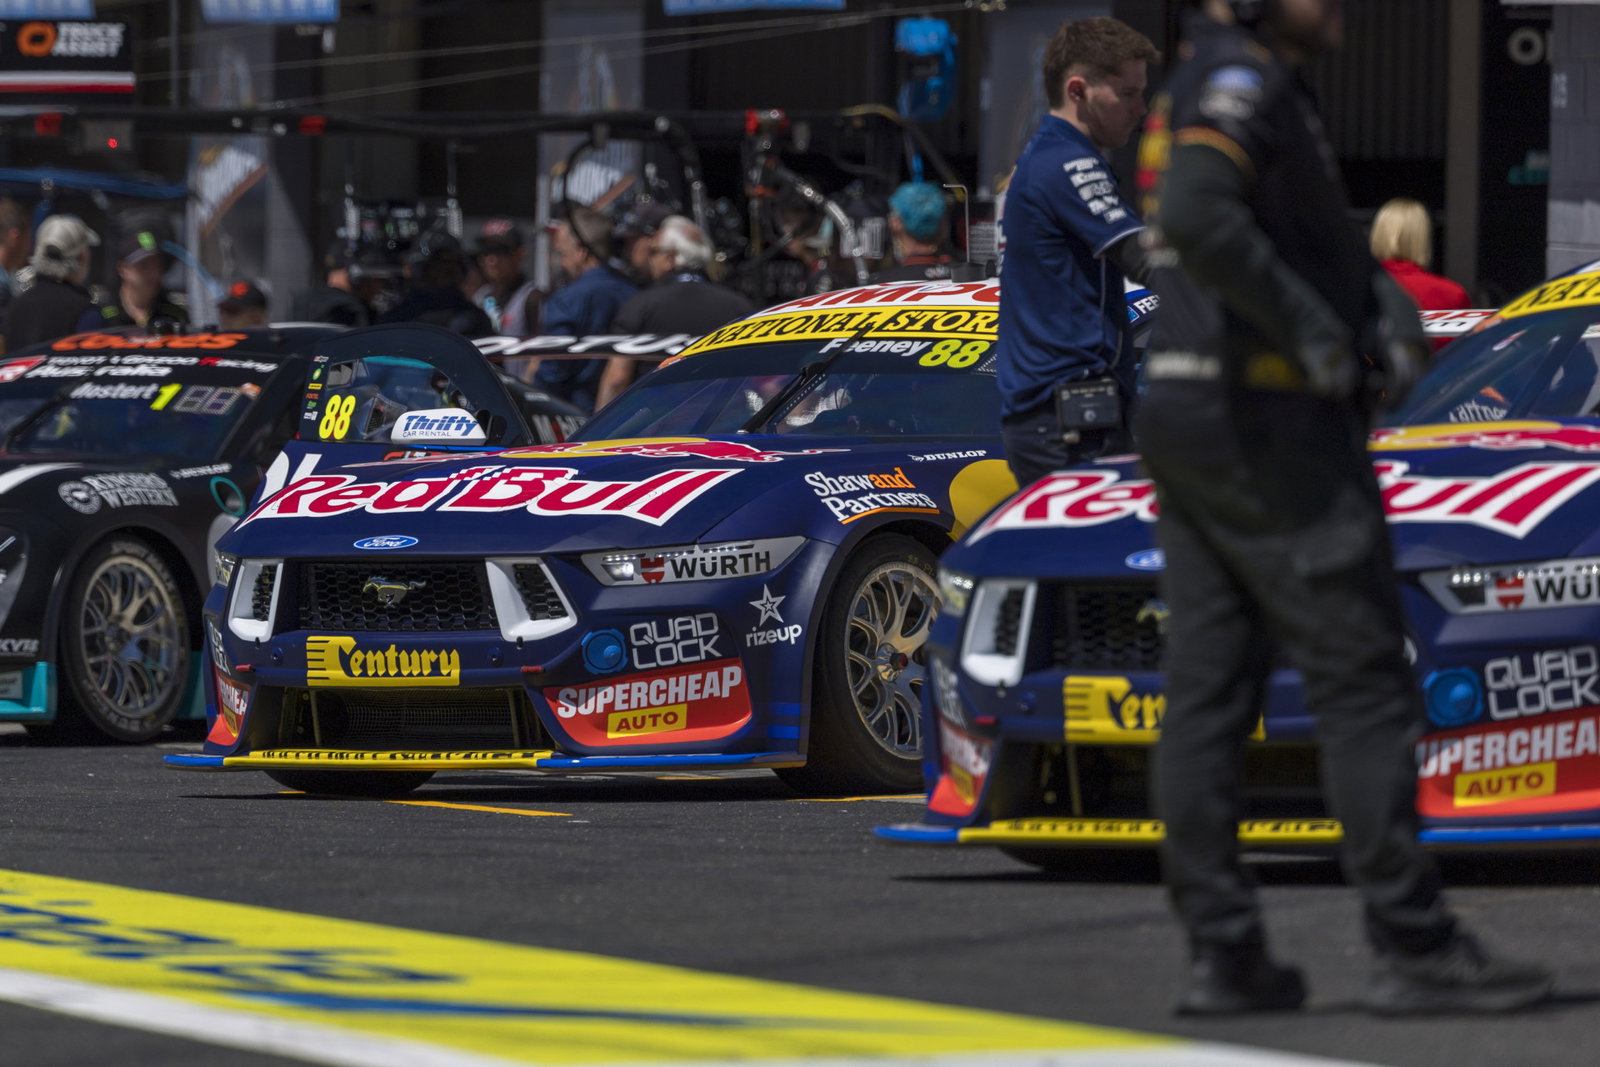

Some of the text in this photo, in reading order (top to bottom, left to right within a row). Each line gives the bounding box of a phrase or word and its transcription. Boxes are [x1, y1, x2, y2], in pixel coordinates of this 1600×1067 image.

[700, 310, 890, 350] NATIONAL
[818, 337, 990, 368] Feney 88
[151, 383, 182, 411] 1
[319, 395, 356, 440] 88
[403, 416, 479, 436] Thrifty
[925, 450, 987, 461] DUNLOP
[240, 466, 505, 527] Red
[436, 468, 746, 527] Bull
[820, 492, 938, 521] Partners
[966, 460, 1600, 546] Re ull
[363, 537, 408, 547] Ford
[671, 551, 771, 579] WÜRTH
[629, 612, 719, 646] QUAD
[746, 623, 803, 648] rizeup
[306, 635, 460, 686] Century
[631, 635, 722, 670] LOCK
[1484, 646, 1598, 690] QUAD
[557, 666, 742, 718] SUPERCHEAP
[1488, 675, 1600, 720] LOCK
[615, 711, 679, 732] AUTO
[1415, 717, 1600, 778] UPERCHEA
[1465, 772, 1543, 797] AUTO
